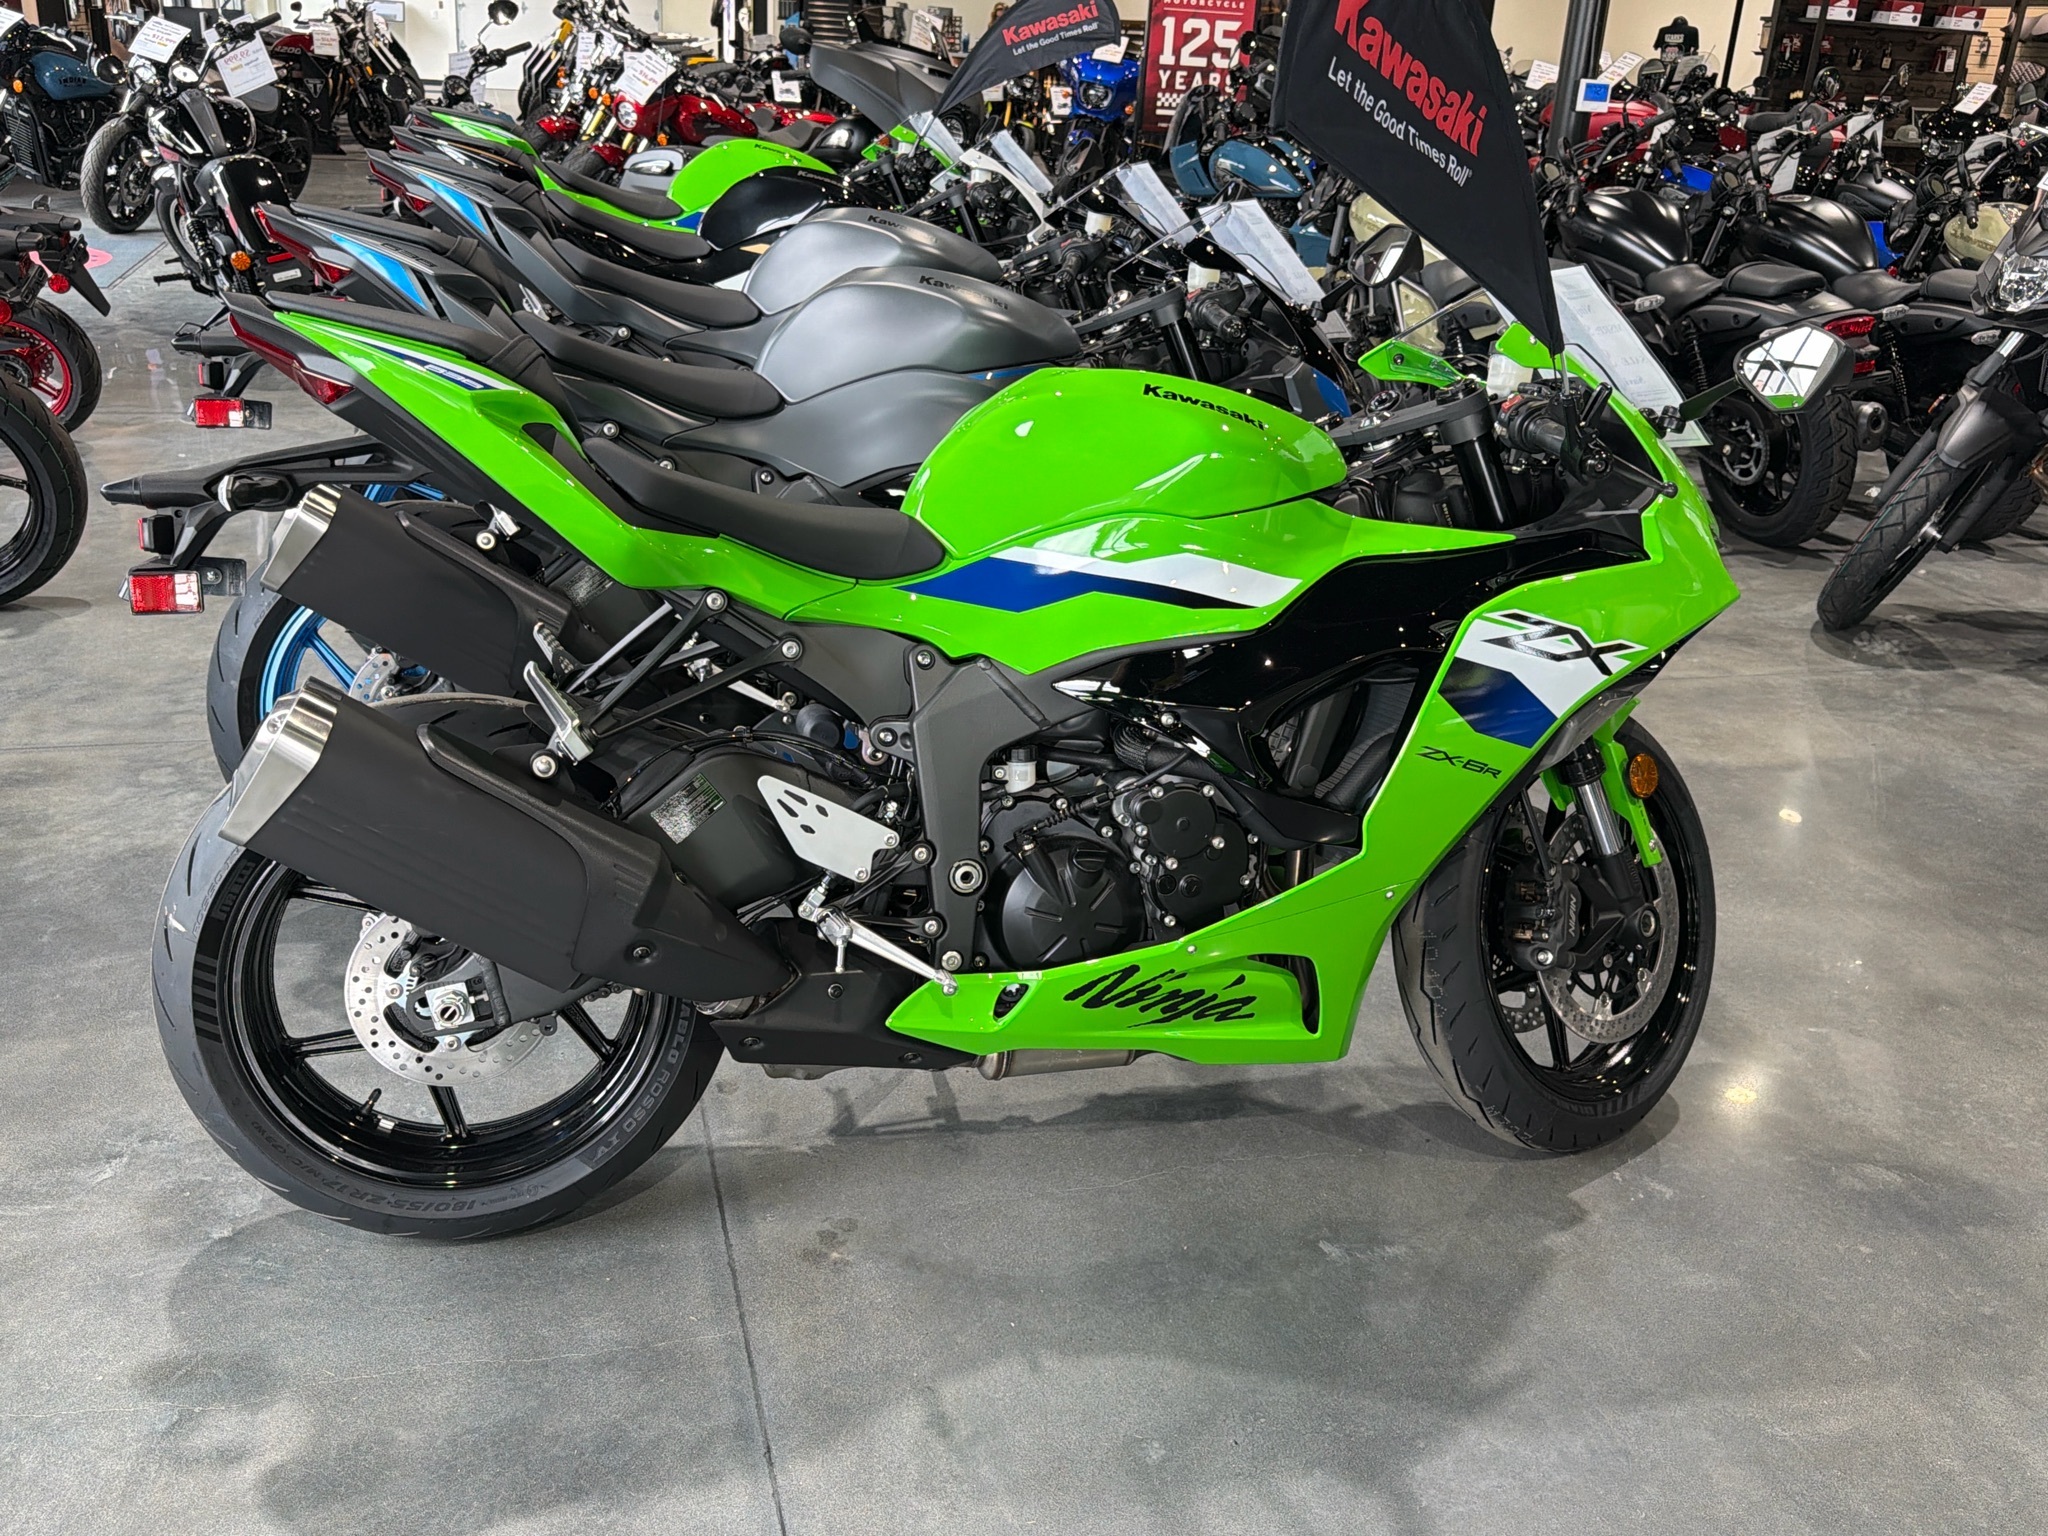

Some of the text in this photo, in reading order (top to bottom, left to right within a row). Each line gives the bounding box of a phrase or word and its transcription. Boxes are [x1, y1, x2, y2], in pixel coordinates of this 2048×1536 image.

[1002, 0, 1099, 46] Kawasaki
[1012, 45, 1025, 56] Let
[1026, 41, 1039, 51] the
[1039, 33, 1060, 46] Good
[1059, 28, 1082, 40] Times
[1159, 16, 1243, 69] 125
[1334, 0, 1488, 157] Kawasaki
[1328, 56, 1352, 93] Let
[1353, 79, 1375, 112] the
[1373, 99, 1406, 141] Good
[1407, 125, 1446, 169] Times
[1143, 383, 1266, 431] Kawasaki
[1415, 745, 1503, 780] ZX-6R
[1063, 963, 1257, 1029] Ninja
[668, 1000, 693, 1066] ABLO
[622, 1068, 671, 1133] ROSSO
